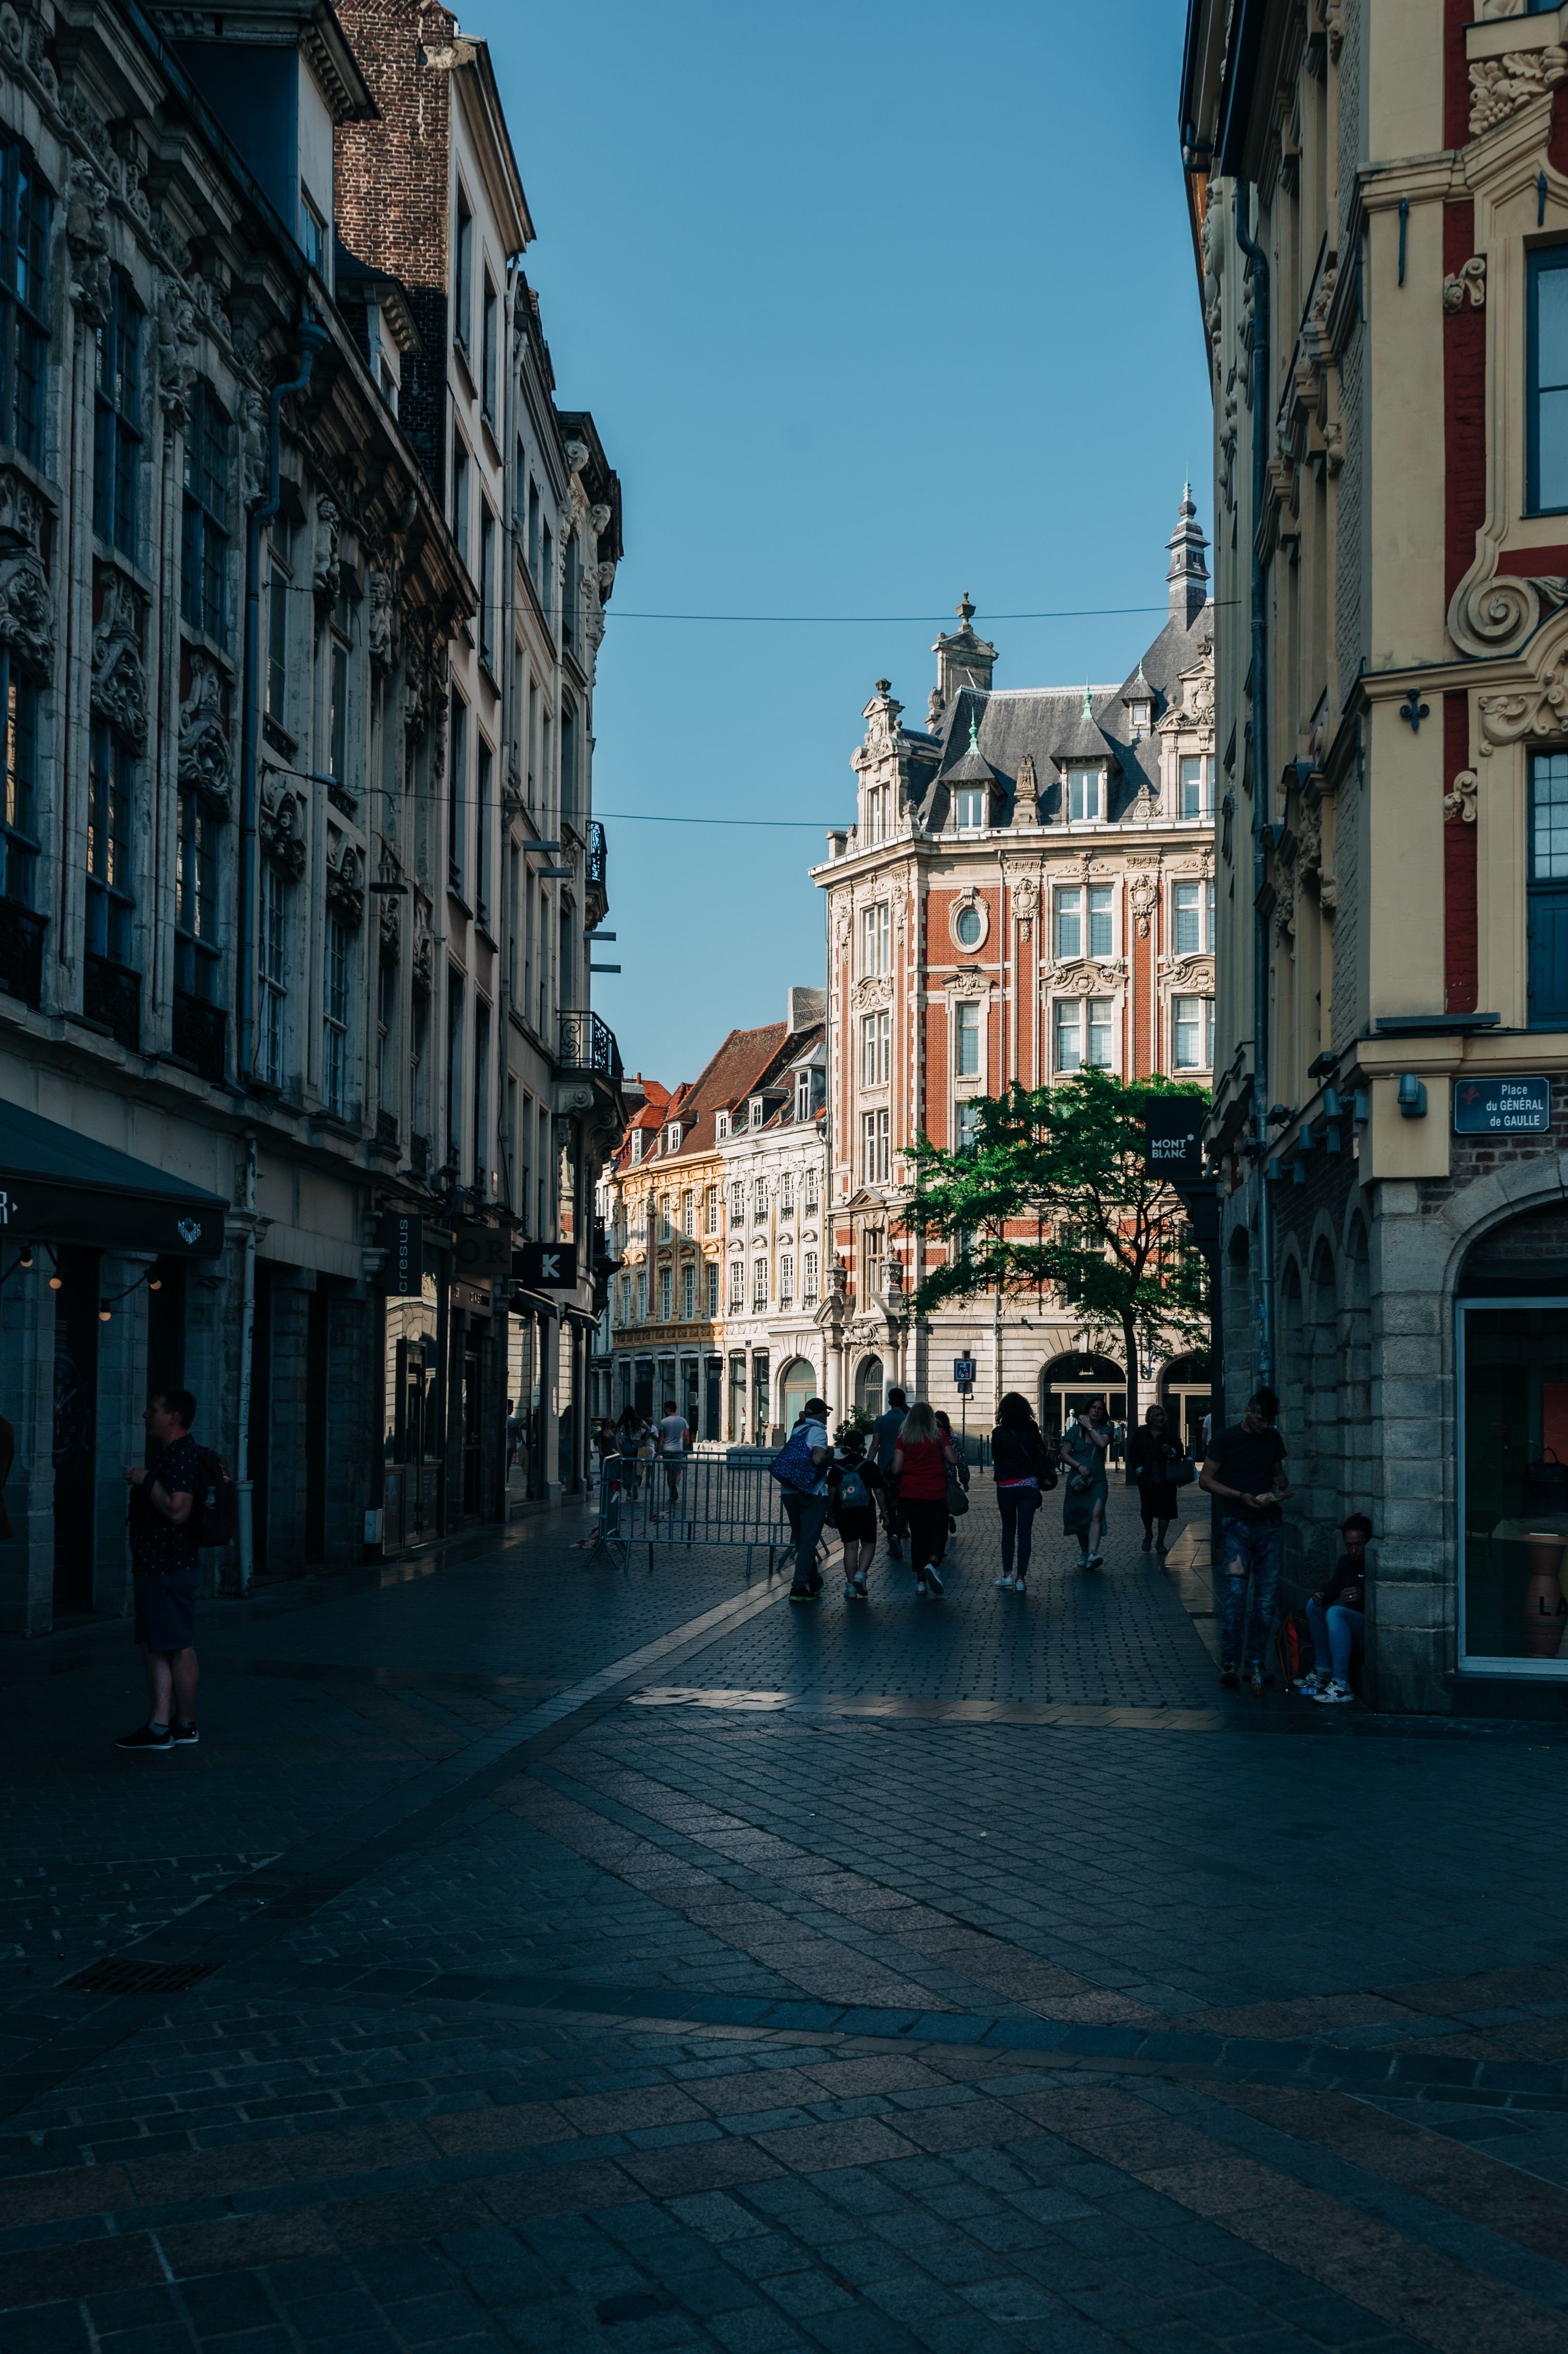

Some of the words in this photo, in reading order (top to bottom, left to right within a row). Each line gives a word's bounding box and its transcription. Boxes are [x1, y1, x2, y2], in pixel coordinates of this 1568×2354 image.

[1501, 1084, 1527, 1095] Place
[1486, 1101, 1497, 1111] du
[1500, 1097, 1544, 1110] GÉNÉRAL
[1490, 1116, 1501, 1127] de
[1504, 1115, 1540, 1126] GAULLE
[1152, 1139, 1186, 1148] MONT
[1152, 1149, 1186, 1158] BLANC
[399, 1220, 408, 1292] cresus
[459, 1239, 508, 1264] OR
[542, 1254, 560, 1278] K
